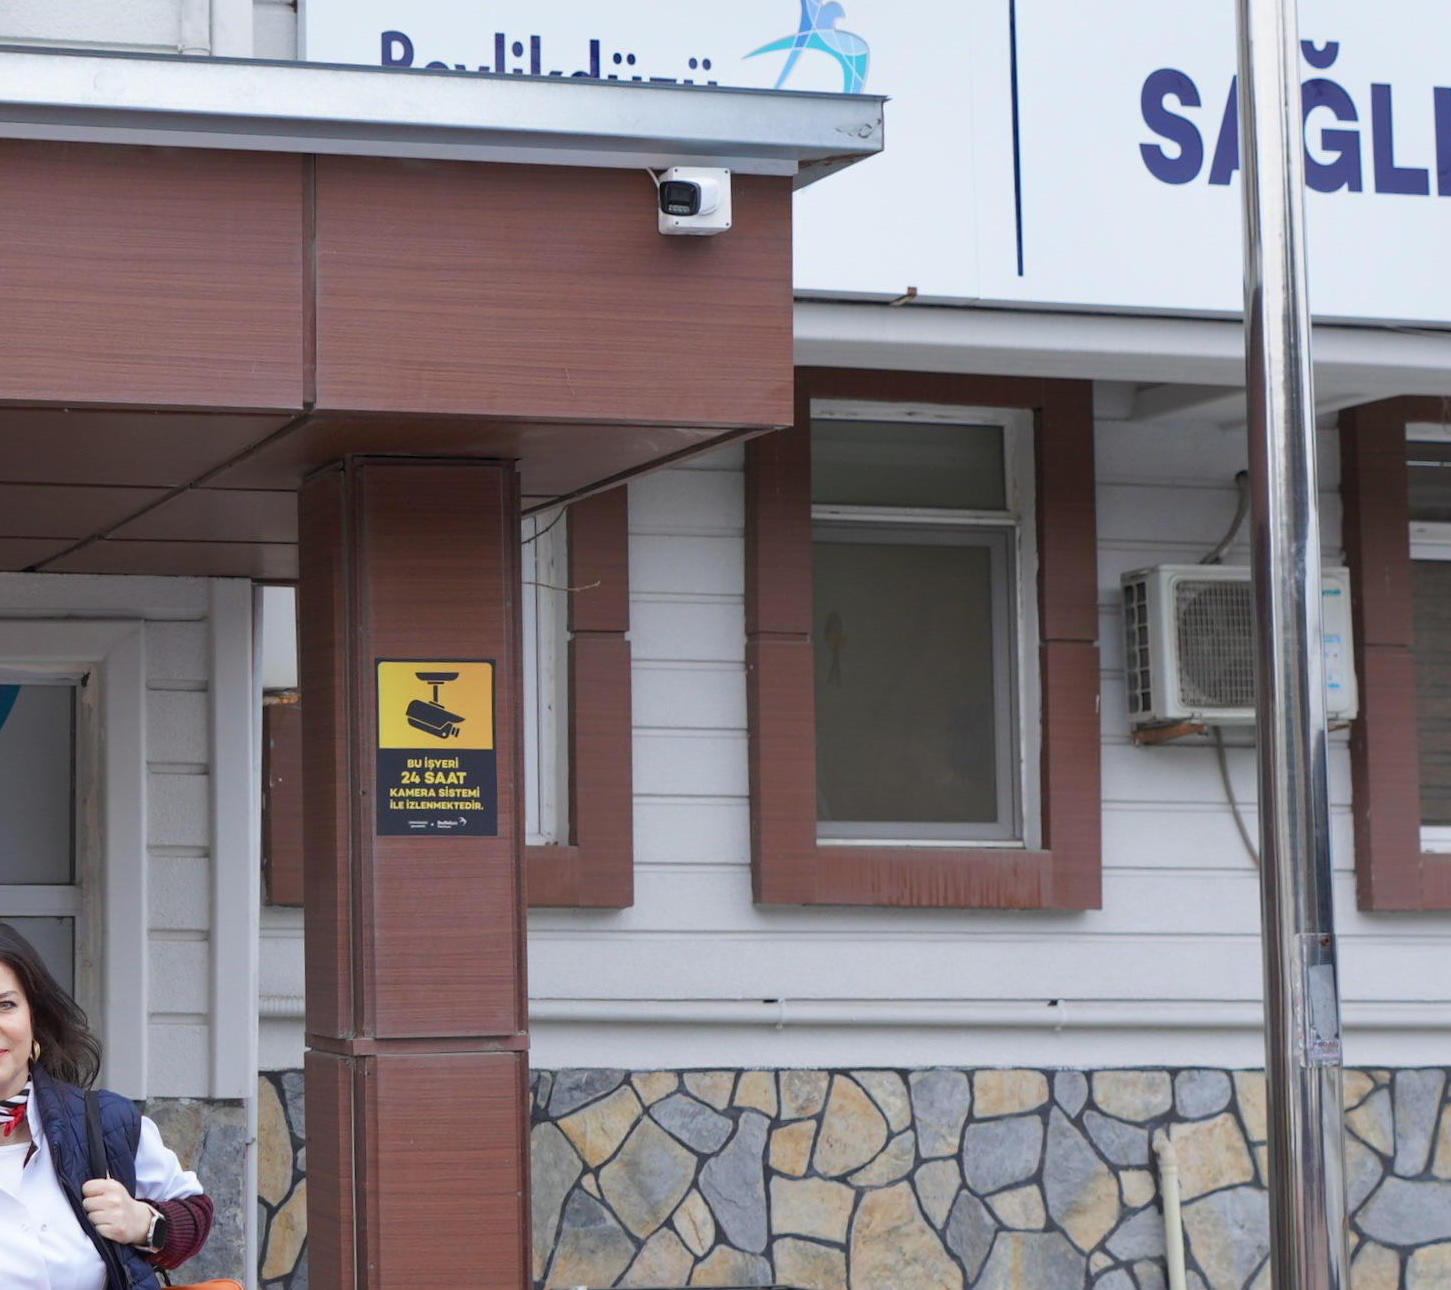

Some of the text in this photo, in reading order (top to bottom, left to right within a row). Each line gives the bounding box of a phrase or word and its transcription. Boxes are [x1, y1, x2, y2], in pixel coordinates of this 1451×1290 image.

[407, 757, 459, 770] BU İŞYERİ
[401, 771, 467, 784] 24 SAAT
[390, 786, 480, 798] KAMERA SİSTEMİ
[390, 799, 484, 810] İLE İZLENMEKTEDİR.
